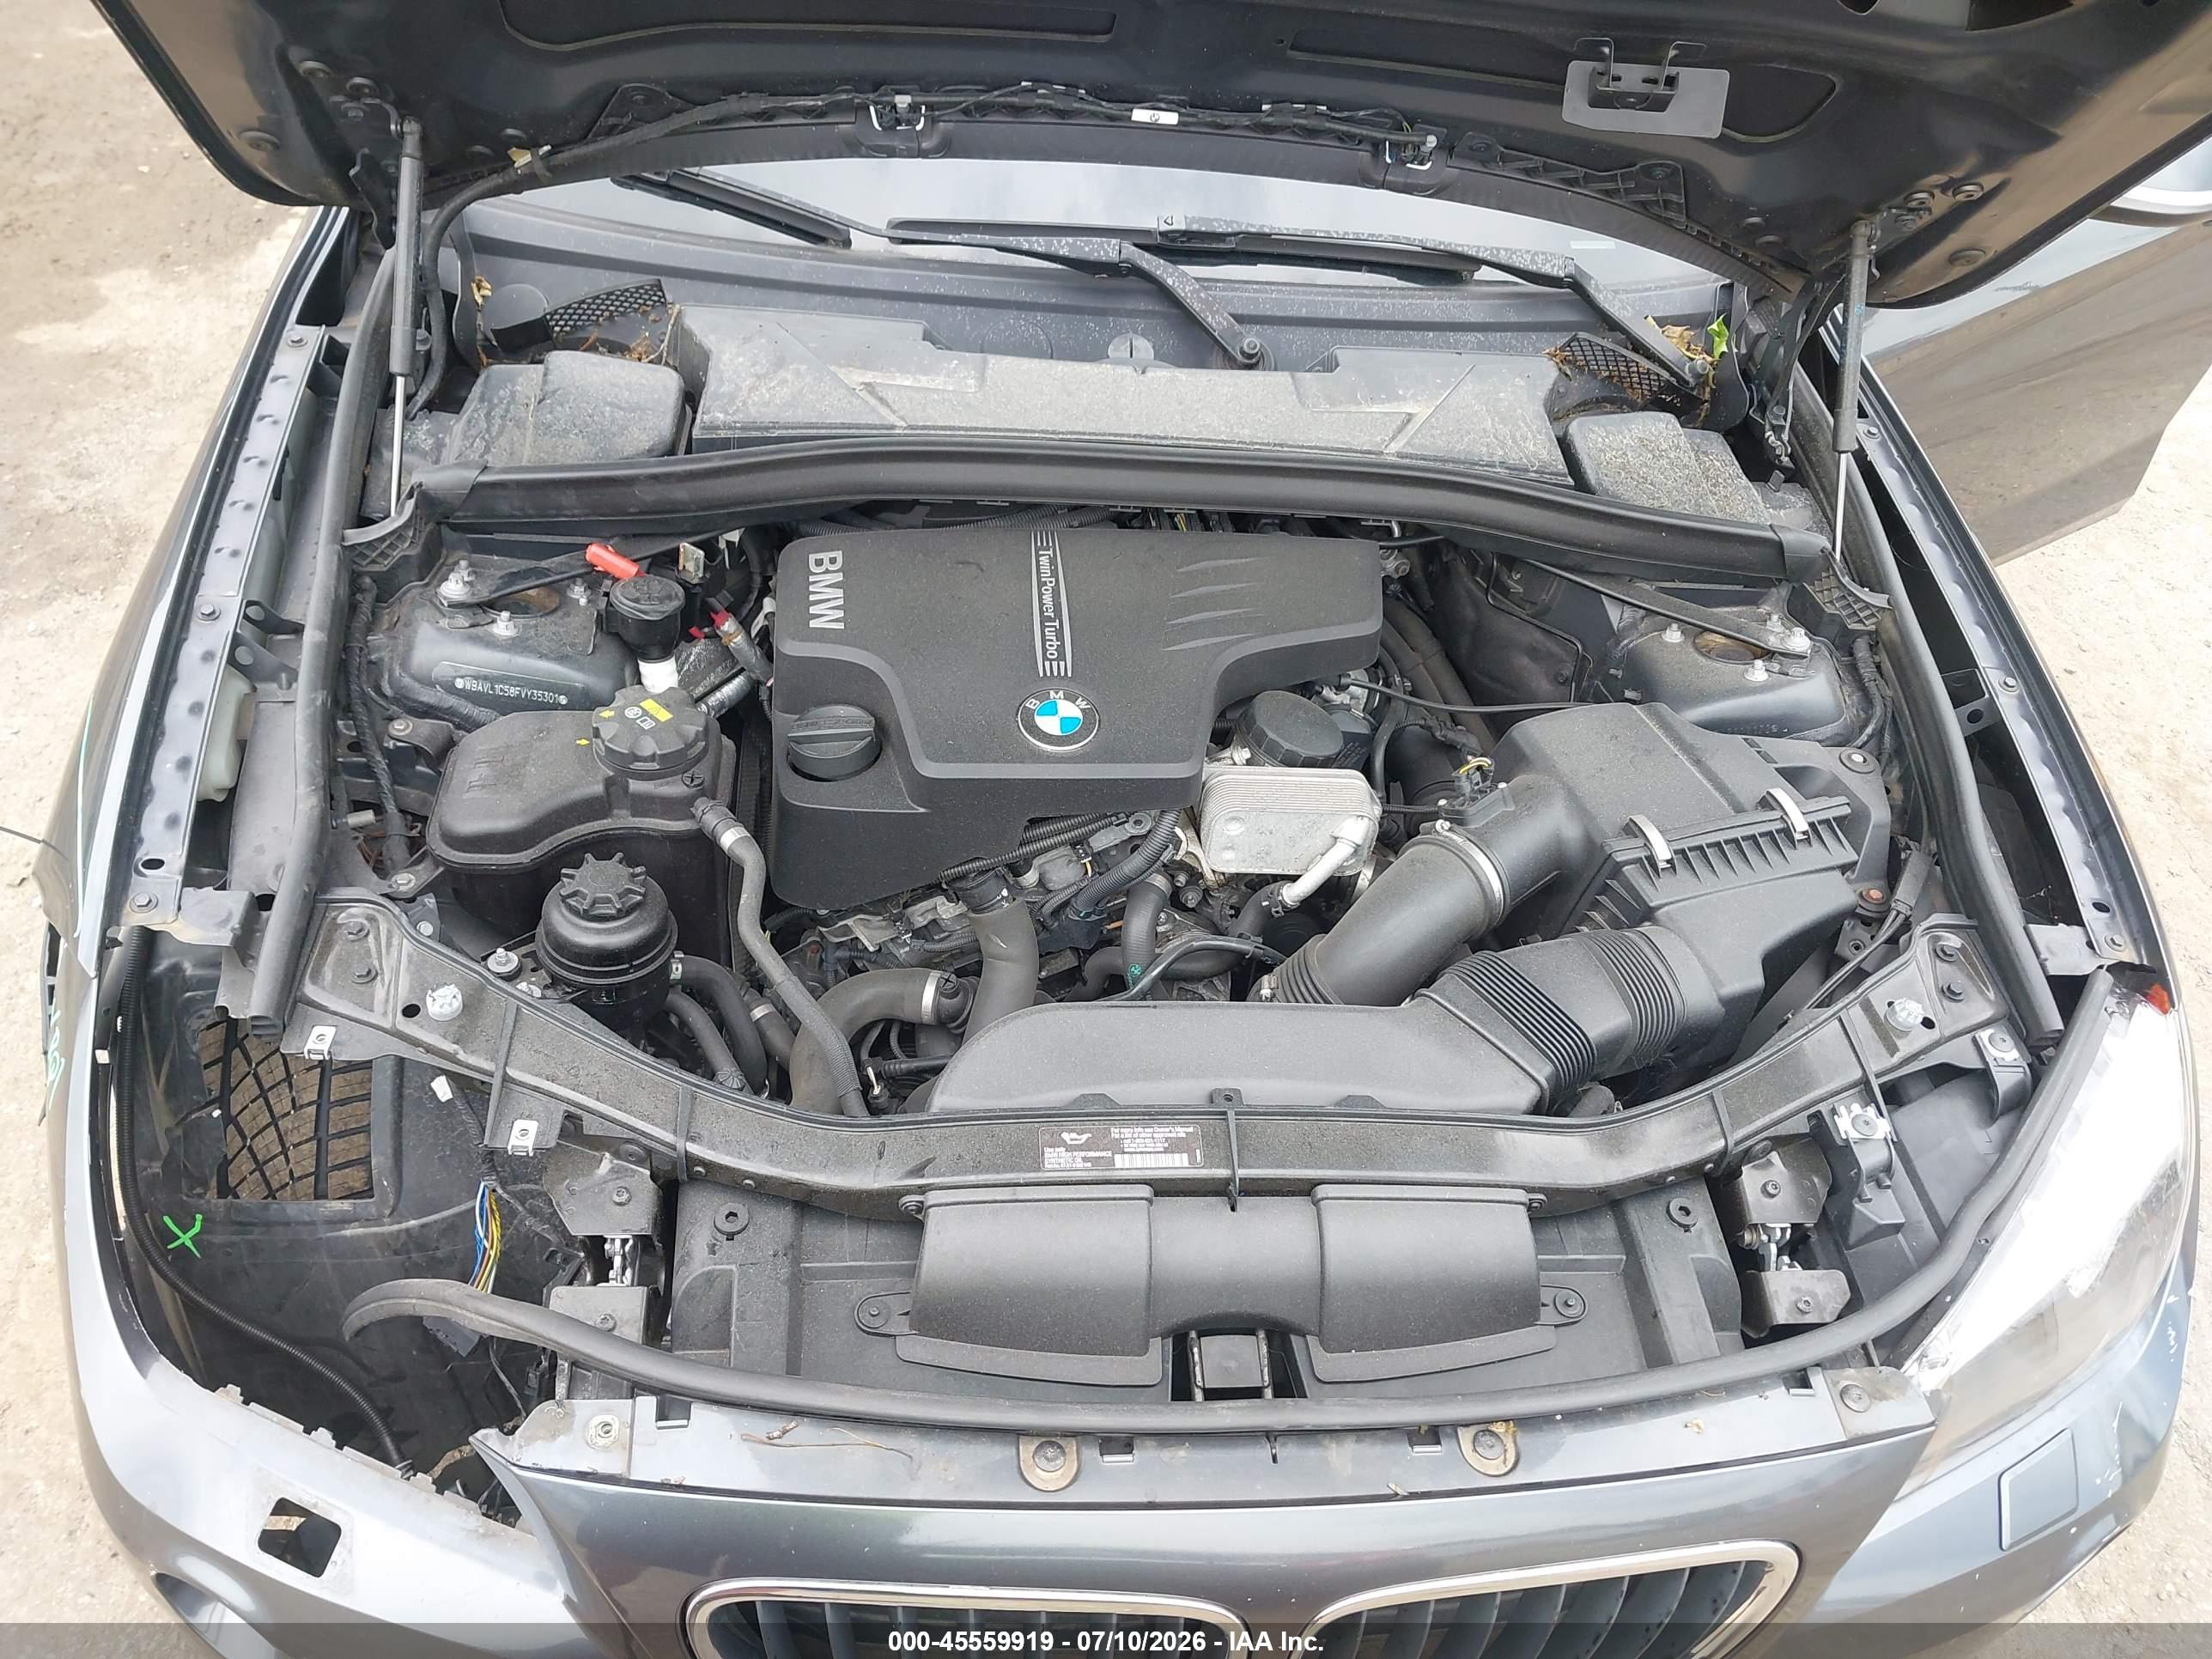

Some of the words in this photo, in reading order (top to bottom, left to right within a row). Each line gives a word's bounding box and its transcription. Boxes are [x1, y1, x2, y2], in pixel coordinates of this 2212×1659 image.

[809, 550, 845, 629] BMW
[1038, 548, 1055, 618] TwinPower
[1044, 619, 1061, 659] Turbo
[1024, 690, 1091, 710] BMW
